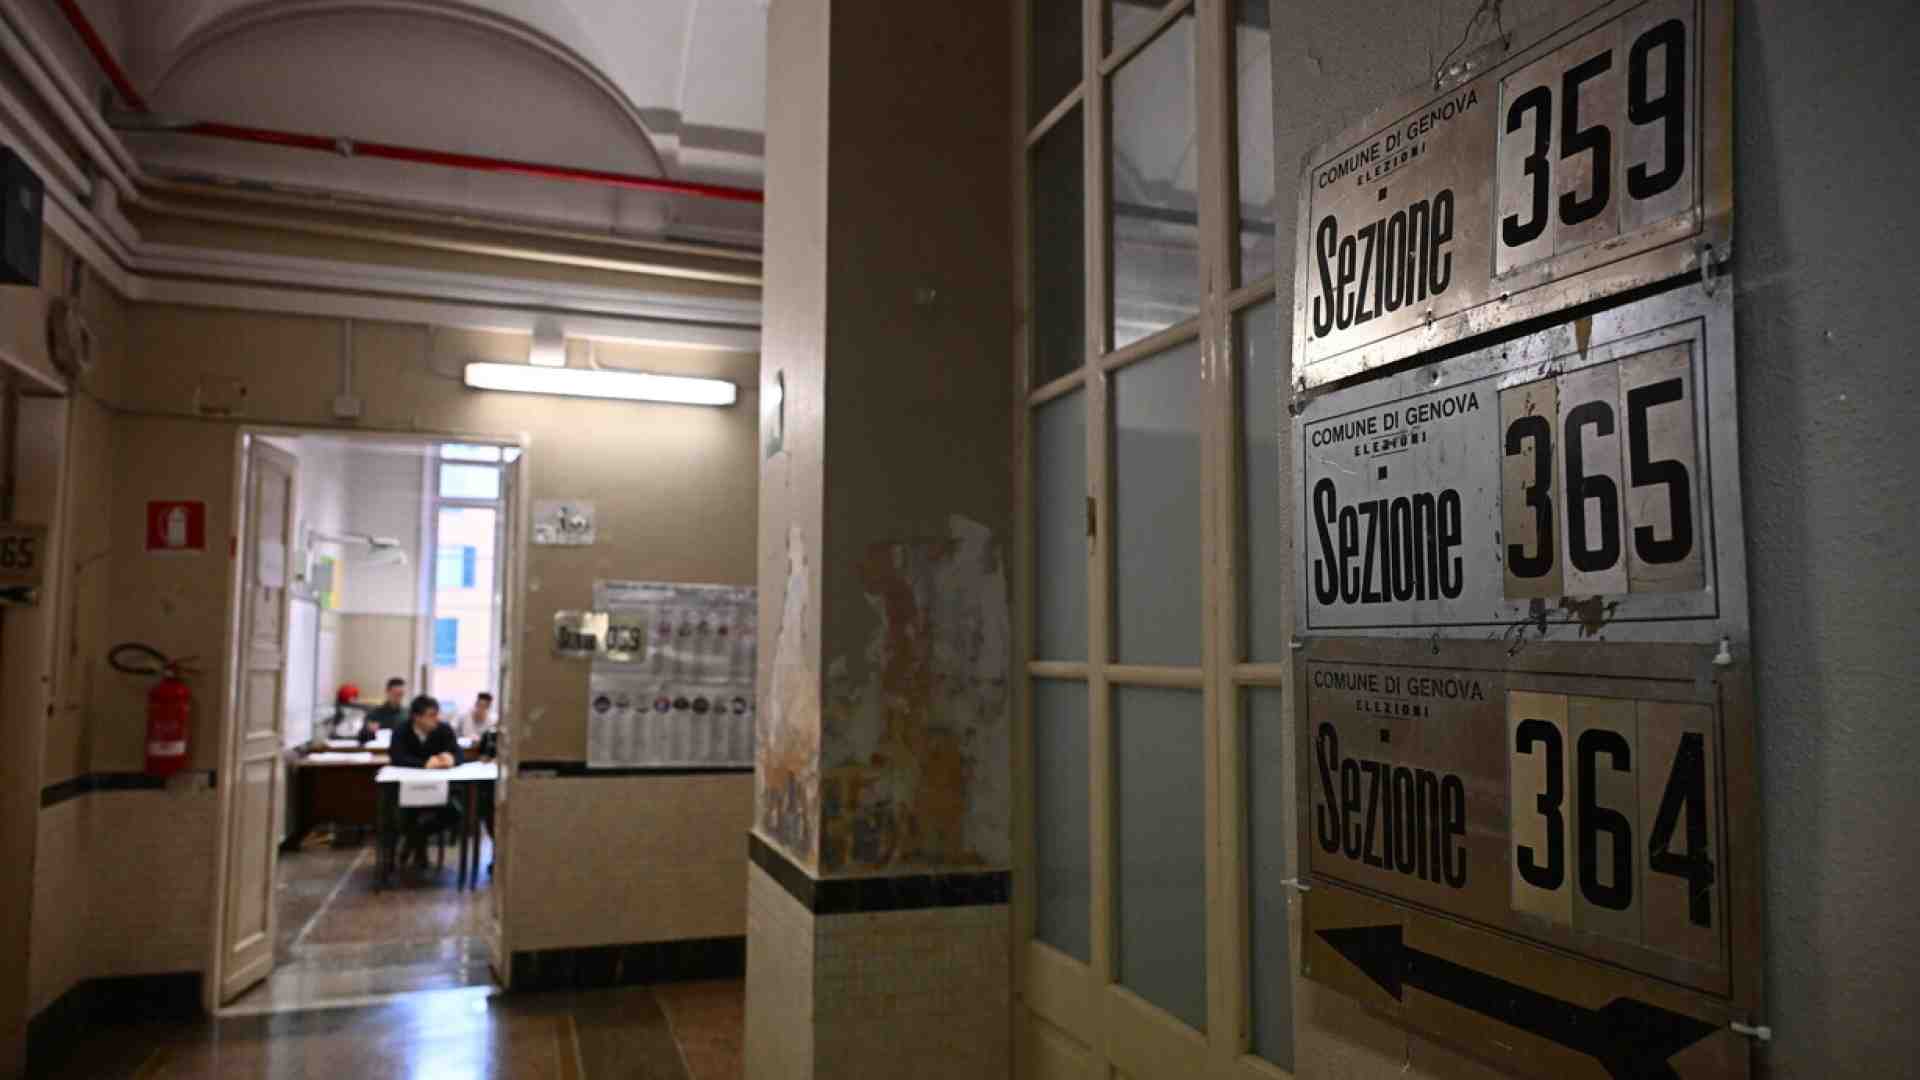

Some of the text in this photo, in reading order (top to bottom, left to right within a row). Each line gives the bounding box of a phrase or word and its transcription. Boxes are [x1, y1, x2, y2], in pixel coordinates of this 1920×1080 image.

[1319, 89, 1479, 188] COMUNE DI GENOVA
[1357, 143, 1427, 186] ELEZIONI
[1312, 18, 1685, 338] Sezione 359
[1312, 392, 1479, 447] COMUNE DI GENOVA
[1354, 432, 1427, 457] ELEZIONI
[1313, 378, 1693, 605] Sezione 365
[1314, 671, 1483, 701] COMUNE DI GENOVA
[1356, 700, 1429, 718] ELEZIONI
[1315, 719, 1715, 928] Sezione 364
